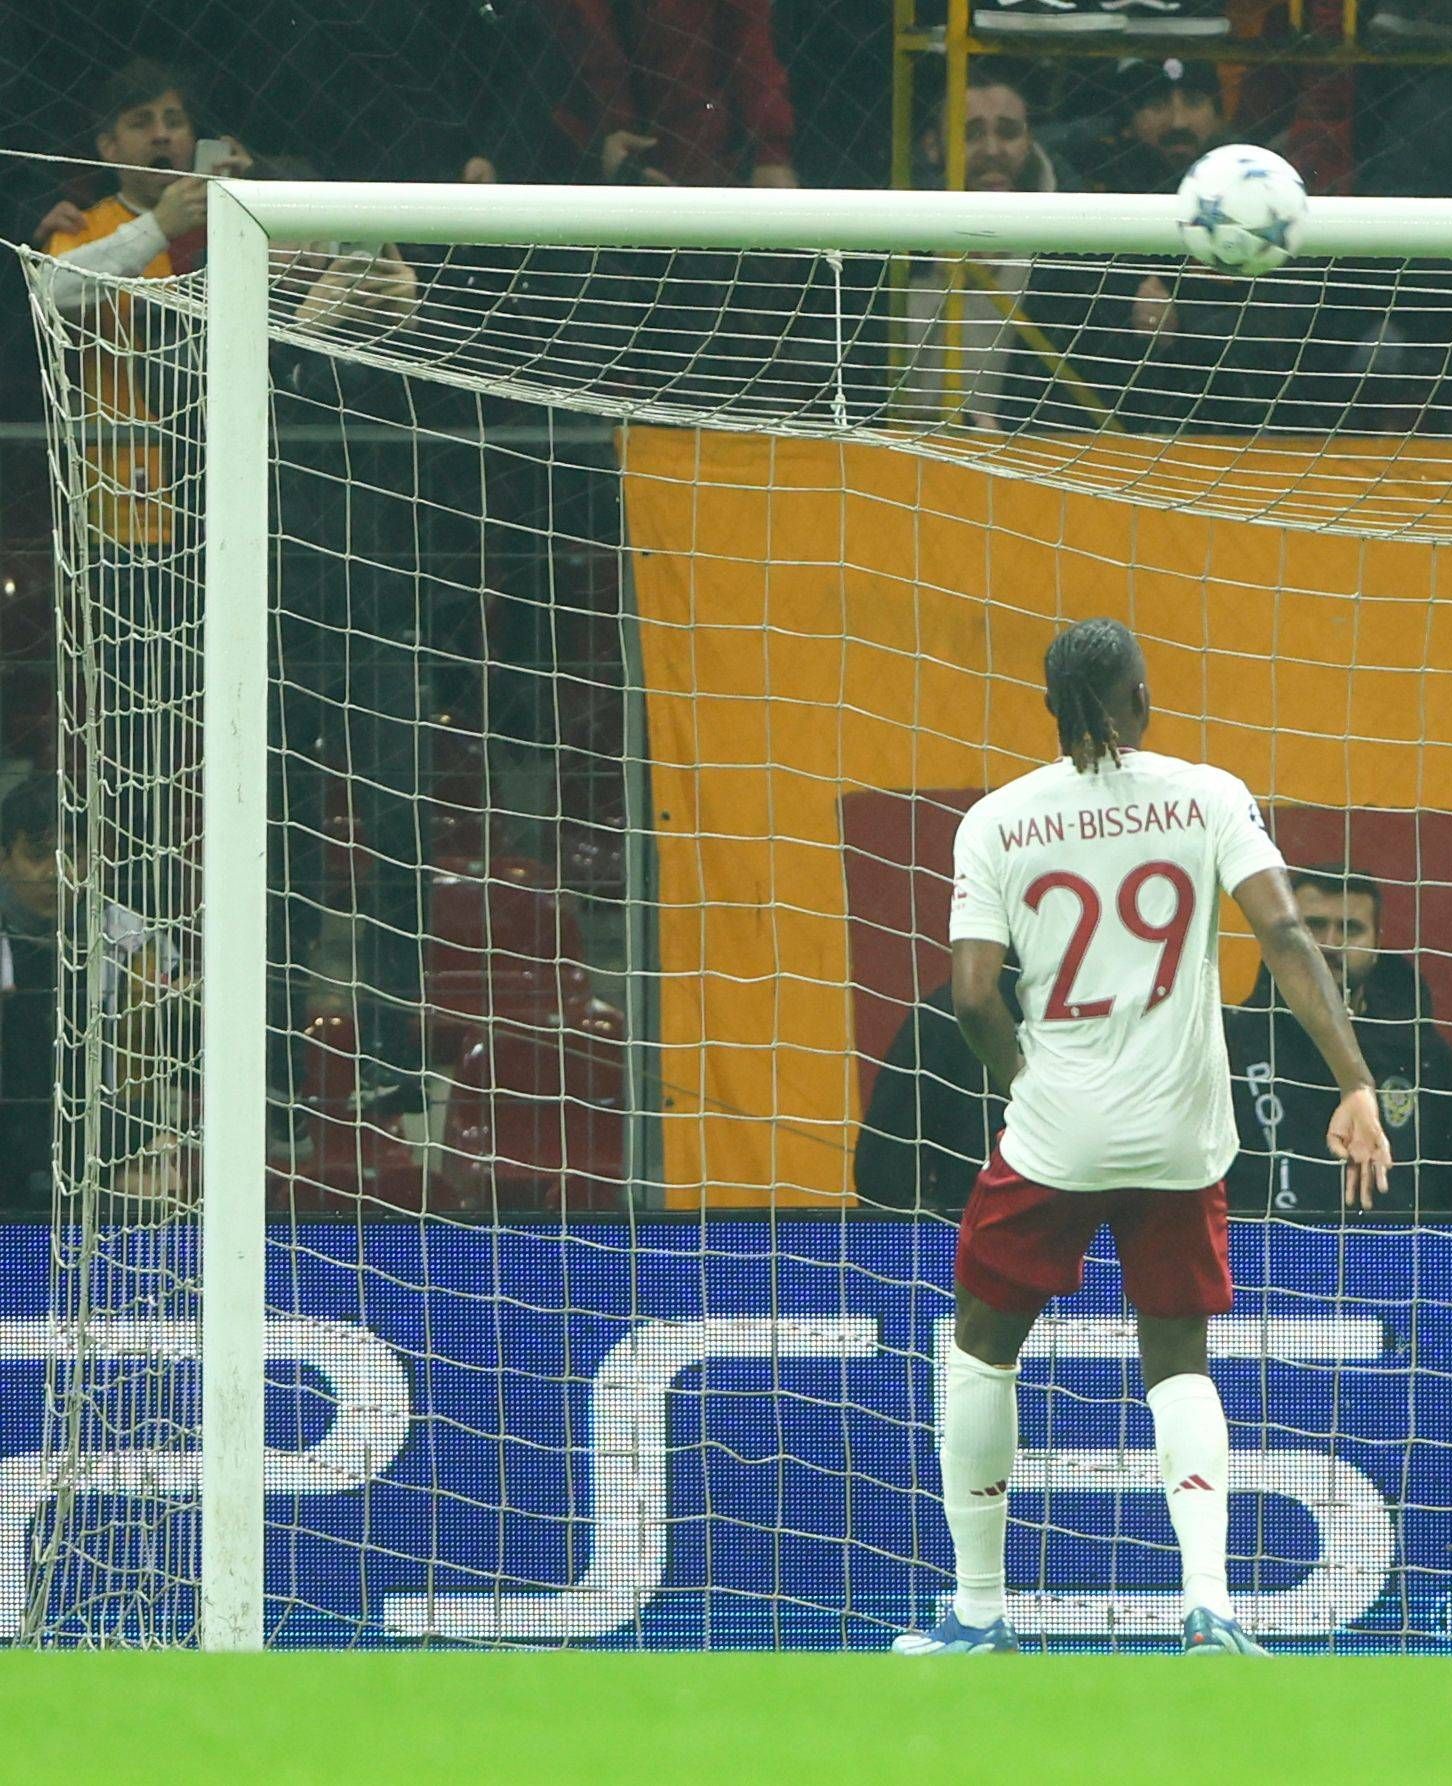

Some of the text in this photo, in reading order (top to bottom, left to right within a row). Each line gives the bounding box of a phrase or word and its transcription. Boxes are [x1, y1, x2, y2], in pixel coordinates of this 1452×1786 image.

[998, 798, 1207, 852] WAN-BISSAKA
[1023, 859, 1197, 1023] 29
[0, 1315, 1396, 1642] PS5
